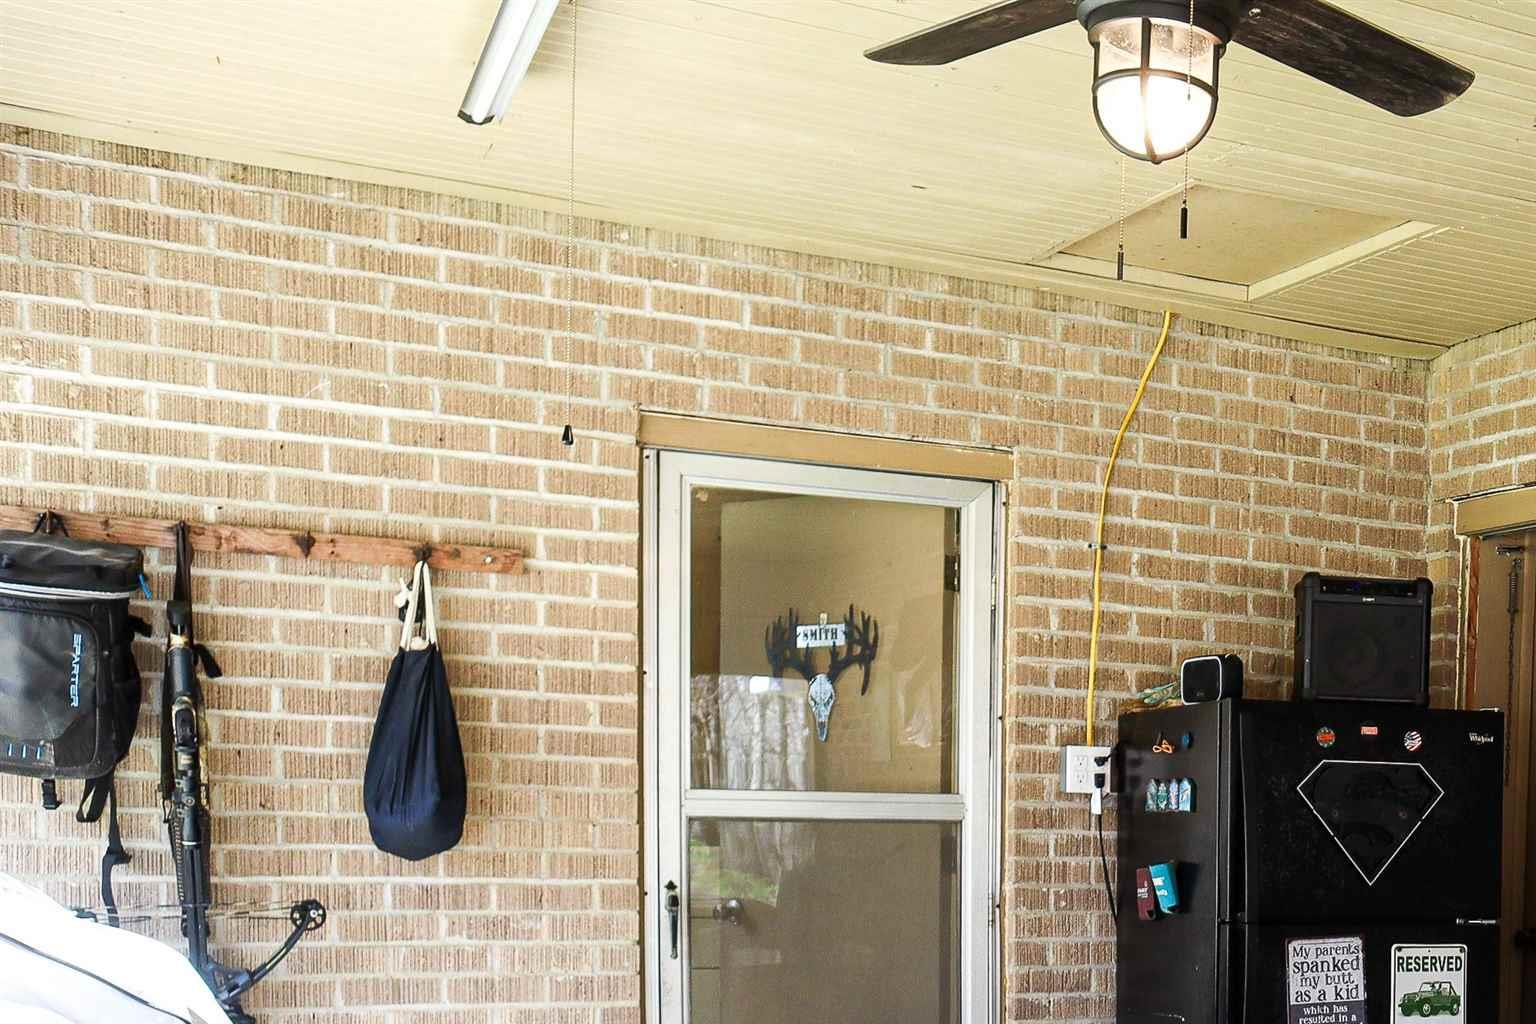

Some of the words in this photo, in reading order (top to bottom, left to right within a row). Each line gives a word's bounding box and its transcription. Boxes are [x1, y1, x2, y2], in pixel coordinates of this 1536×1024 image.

[803, 628, 838, 641] SMITH
[70, 633, 82, 708] SPARTER
[1293, 945, 1311, 960] My
[1315, 944, 1360, 959] parents
[1293, 955, 1361, 976] spanked
[1397, 956, 1463, 973] RESERVED
[1300, 975, 1320, 989] my
[1325, 972, 1355, 985] butt
[1295, 989, 1312, 1002] as
[1317, 989, 1327, 1001] a
[1334, 984, 1360, 1000] kid
[1303, 1004, 1330, 1015] which
[1333, 1004, 1348, 1013] has
[1299, 1014, 1335, 1024] resulted
[1339, 1013, 1348, 1023] in
